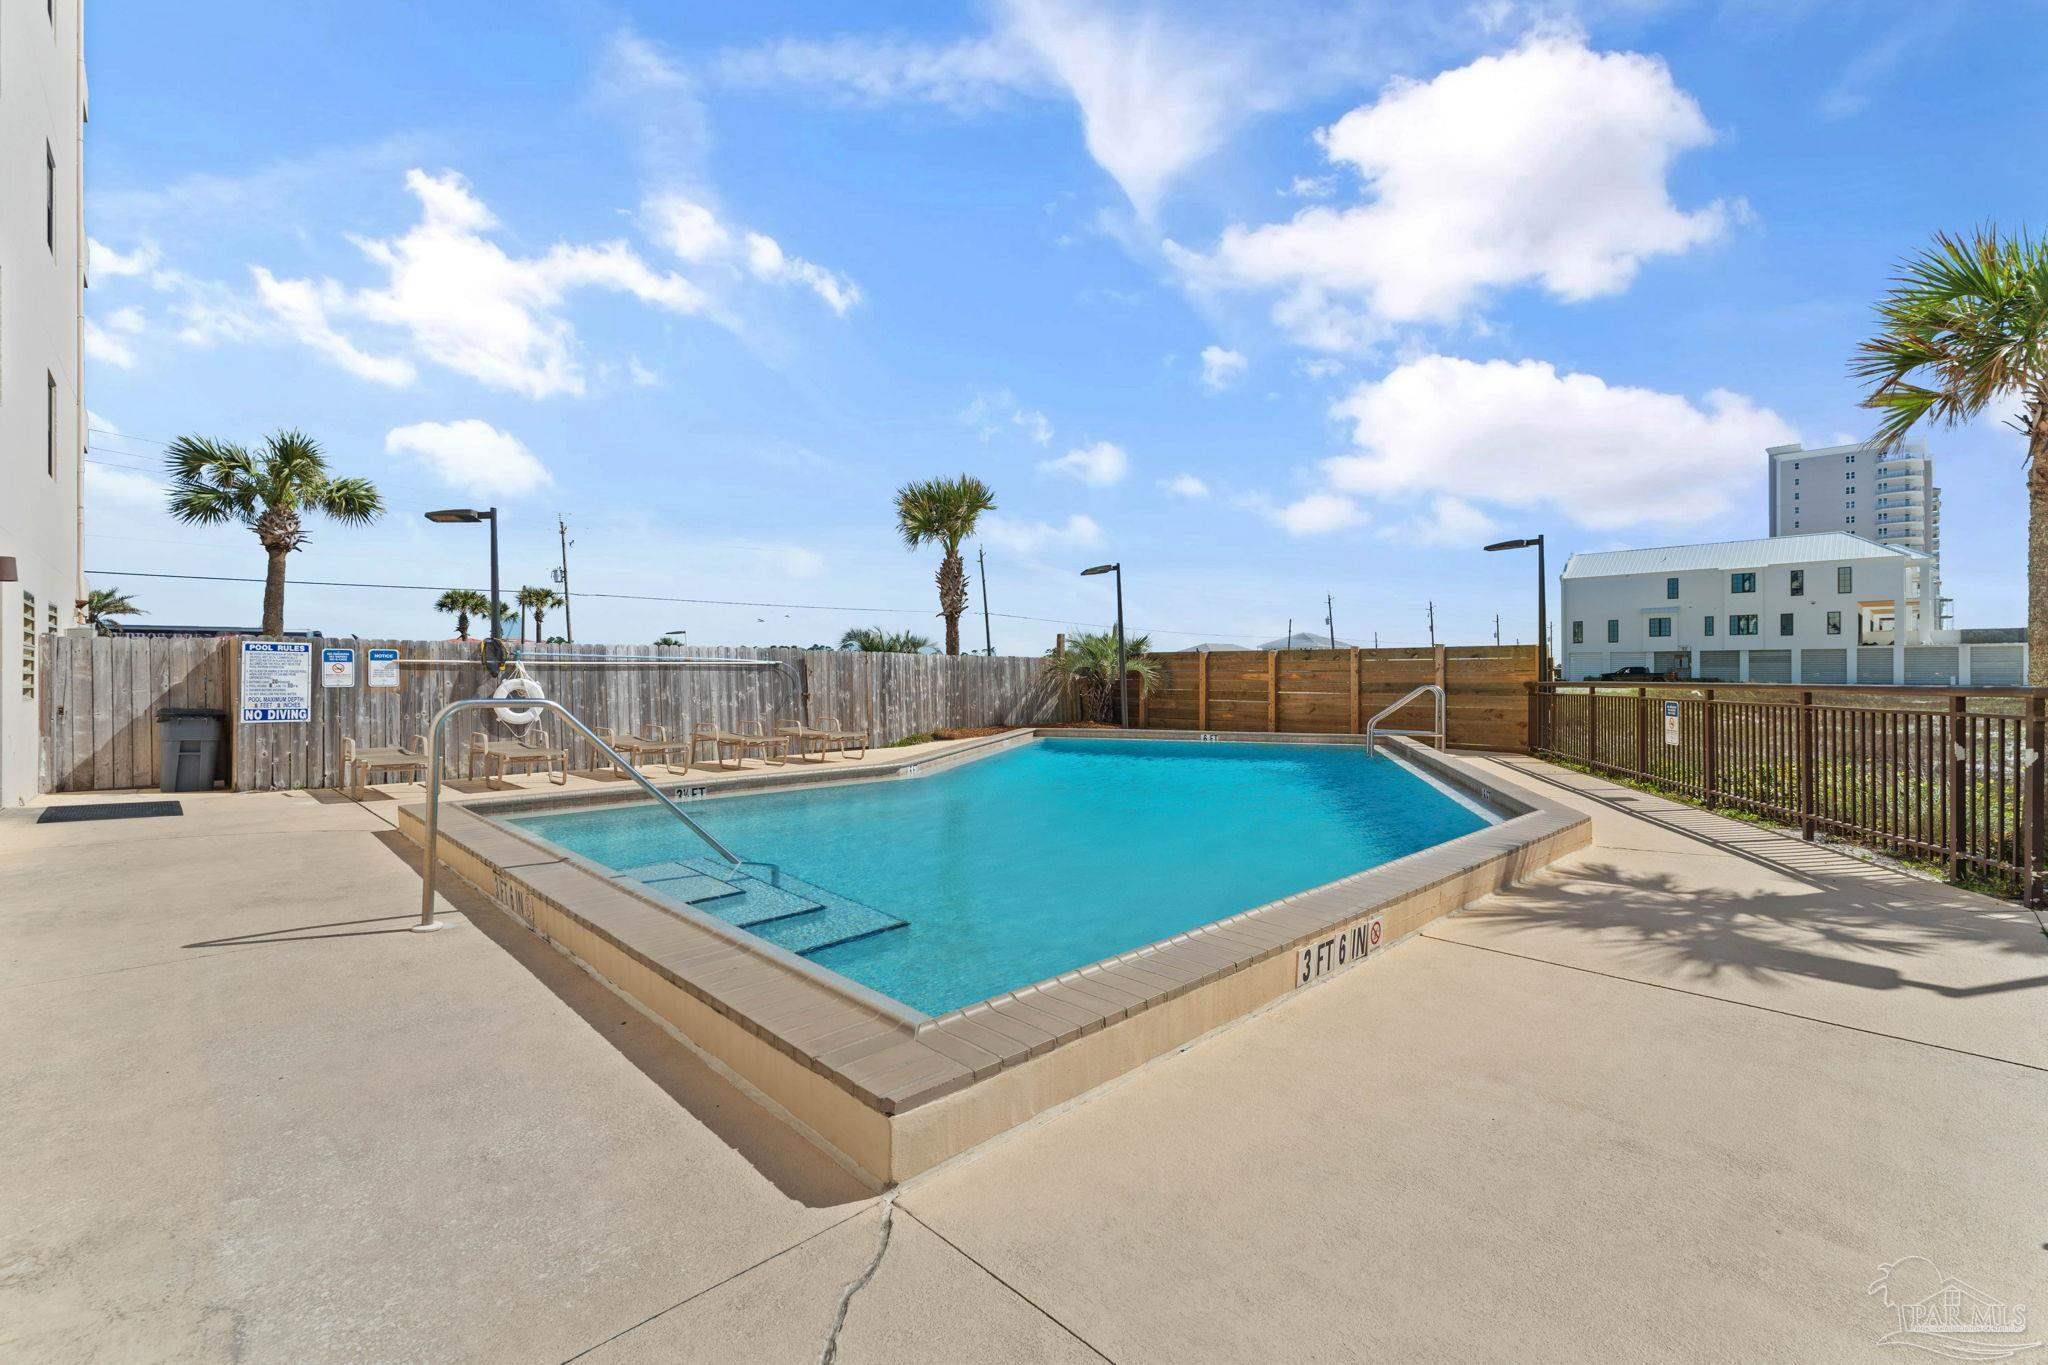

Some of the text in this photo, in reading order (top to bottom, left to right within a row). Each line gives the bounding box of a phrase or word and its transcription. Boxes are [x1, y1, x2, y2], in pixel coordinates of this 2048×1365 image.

[245, 709, 307, 720] NO DIVING
[1302, 924, 1367, 982] 3 FT 6 IN
